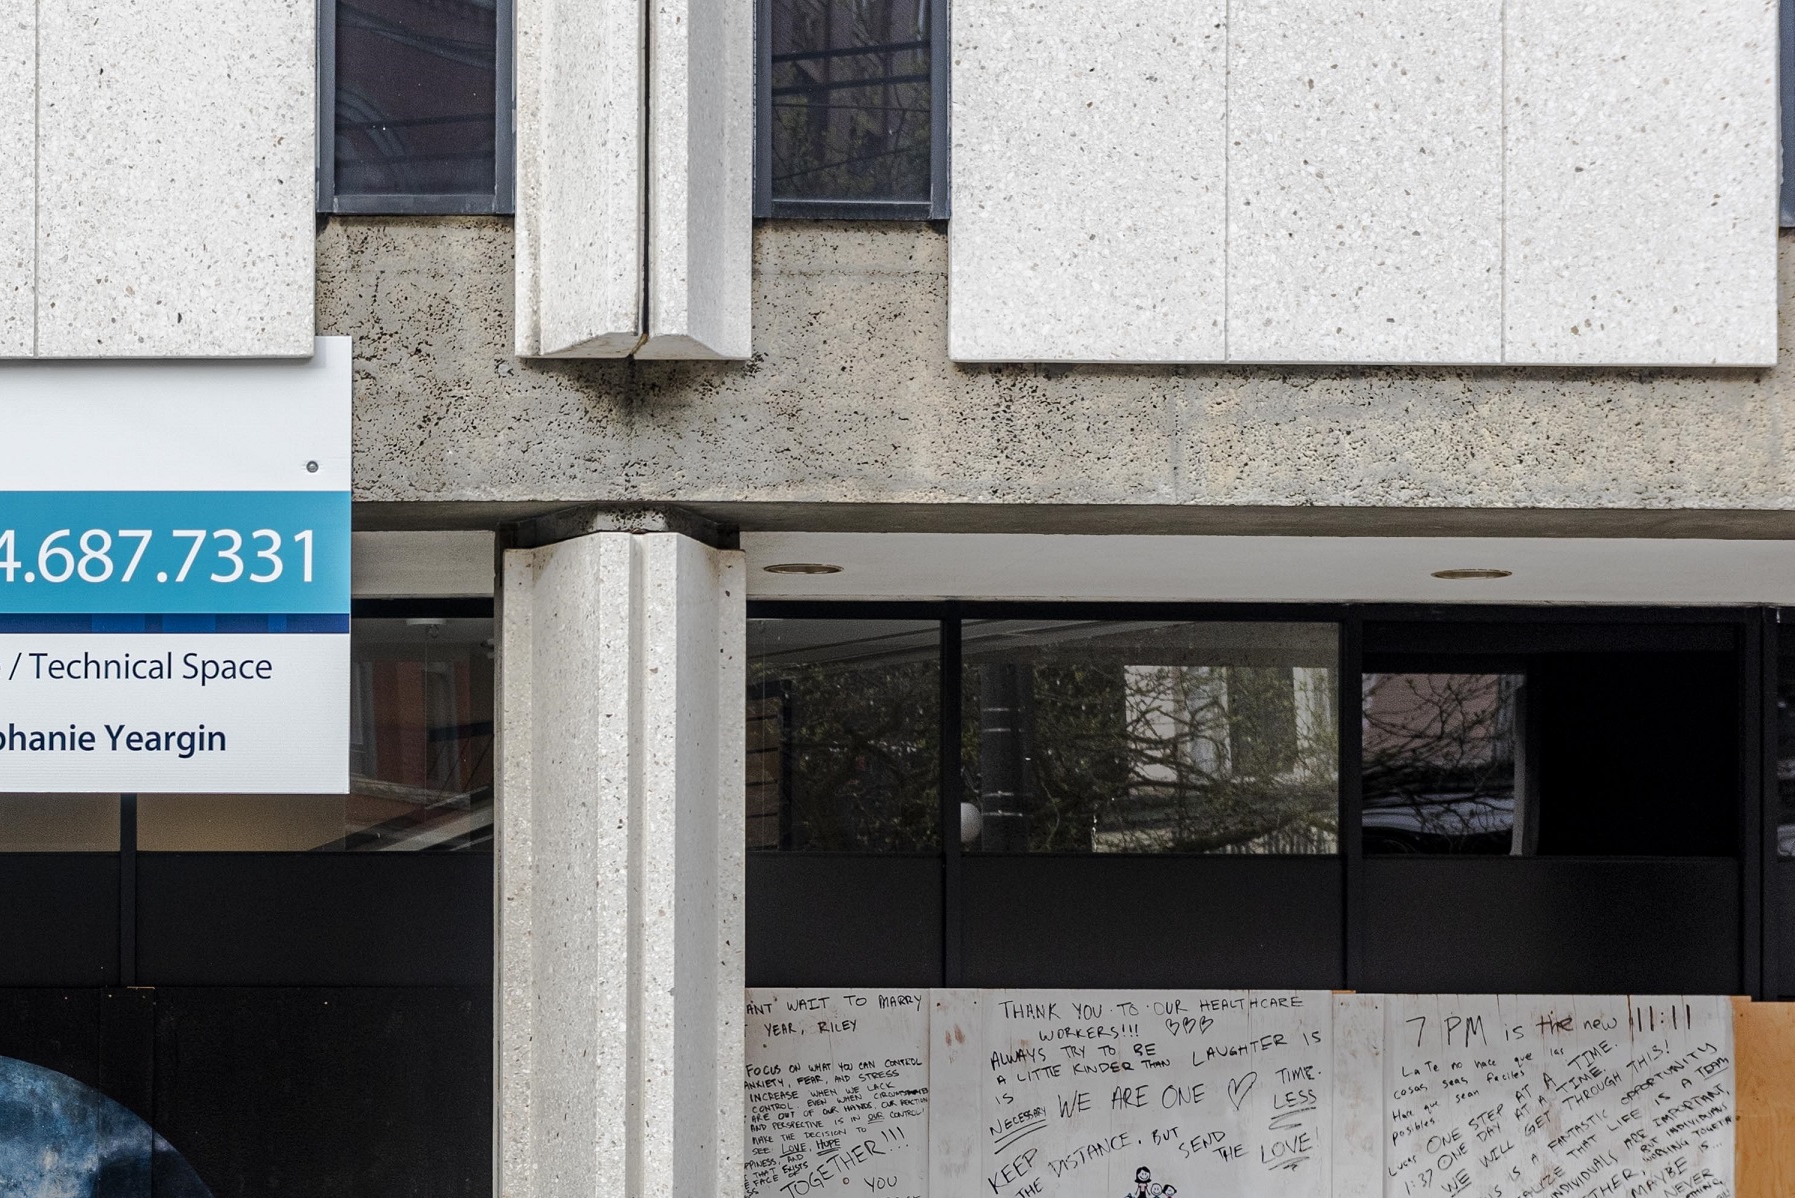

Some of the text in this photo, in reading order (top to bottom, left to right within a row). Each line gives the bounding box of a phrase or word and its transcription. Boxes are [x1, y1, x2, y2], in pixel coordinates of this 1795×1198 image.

[9, 653, 21, 681] /
[29, 652, 172, 679] Technical
[183, 652, 272, 686] Space
[104, 724, 226, 758] Yeargin
[787, 995, 922, 1012] WAIT TO MARRY
[999, 997, 1304, 1020] THANK YOU TO OUR HEALTHCARE
[764, 1020, 857, 1036] YEAR, RILEY
[1039, 1024, 1139, 1041] WORKERS!!!
[1406, 1016, 1426, 1047] 7
[1444, 1015, 1487, 1047] PM
[1505, 1023, 1524, 1041] is
[1536, 1009, 1574, 1036] the
[1584, 1018, 1617, 1032] new
[991, 1044, 1156, 1070] ALWAYS TRY TO BE
[1192, 1031, 1321, 1067] LAUGHTER IS
[997, 1059, 1171, 1085] A LITTLE KINDER THAN
[996, 1094, 1014, 1104] IS
[1058, 1083, 1205, 1118] WE ARE ONE
[1274, 1090, 1317, 1109] LESS
[989, 1107, 1046, 1135] NECESSARY
[1152, 1126, 1179, 1145] BUT
[1179, 1130, 1226, 1158] SEND
[1213, 1128, 1319, 1163] THE LOVE!
[864, 1176, 898, 1192] YOU
[988, 1148, 1037, 1194] KEEP
